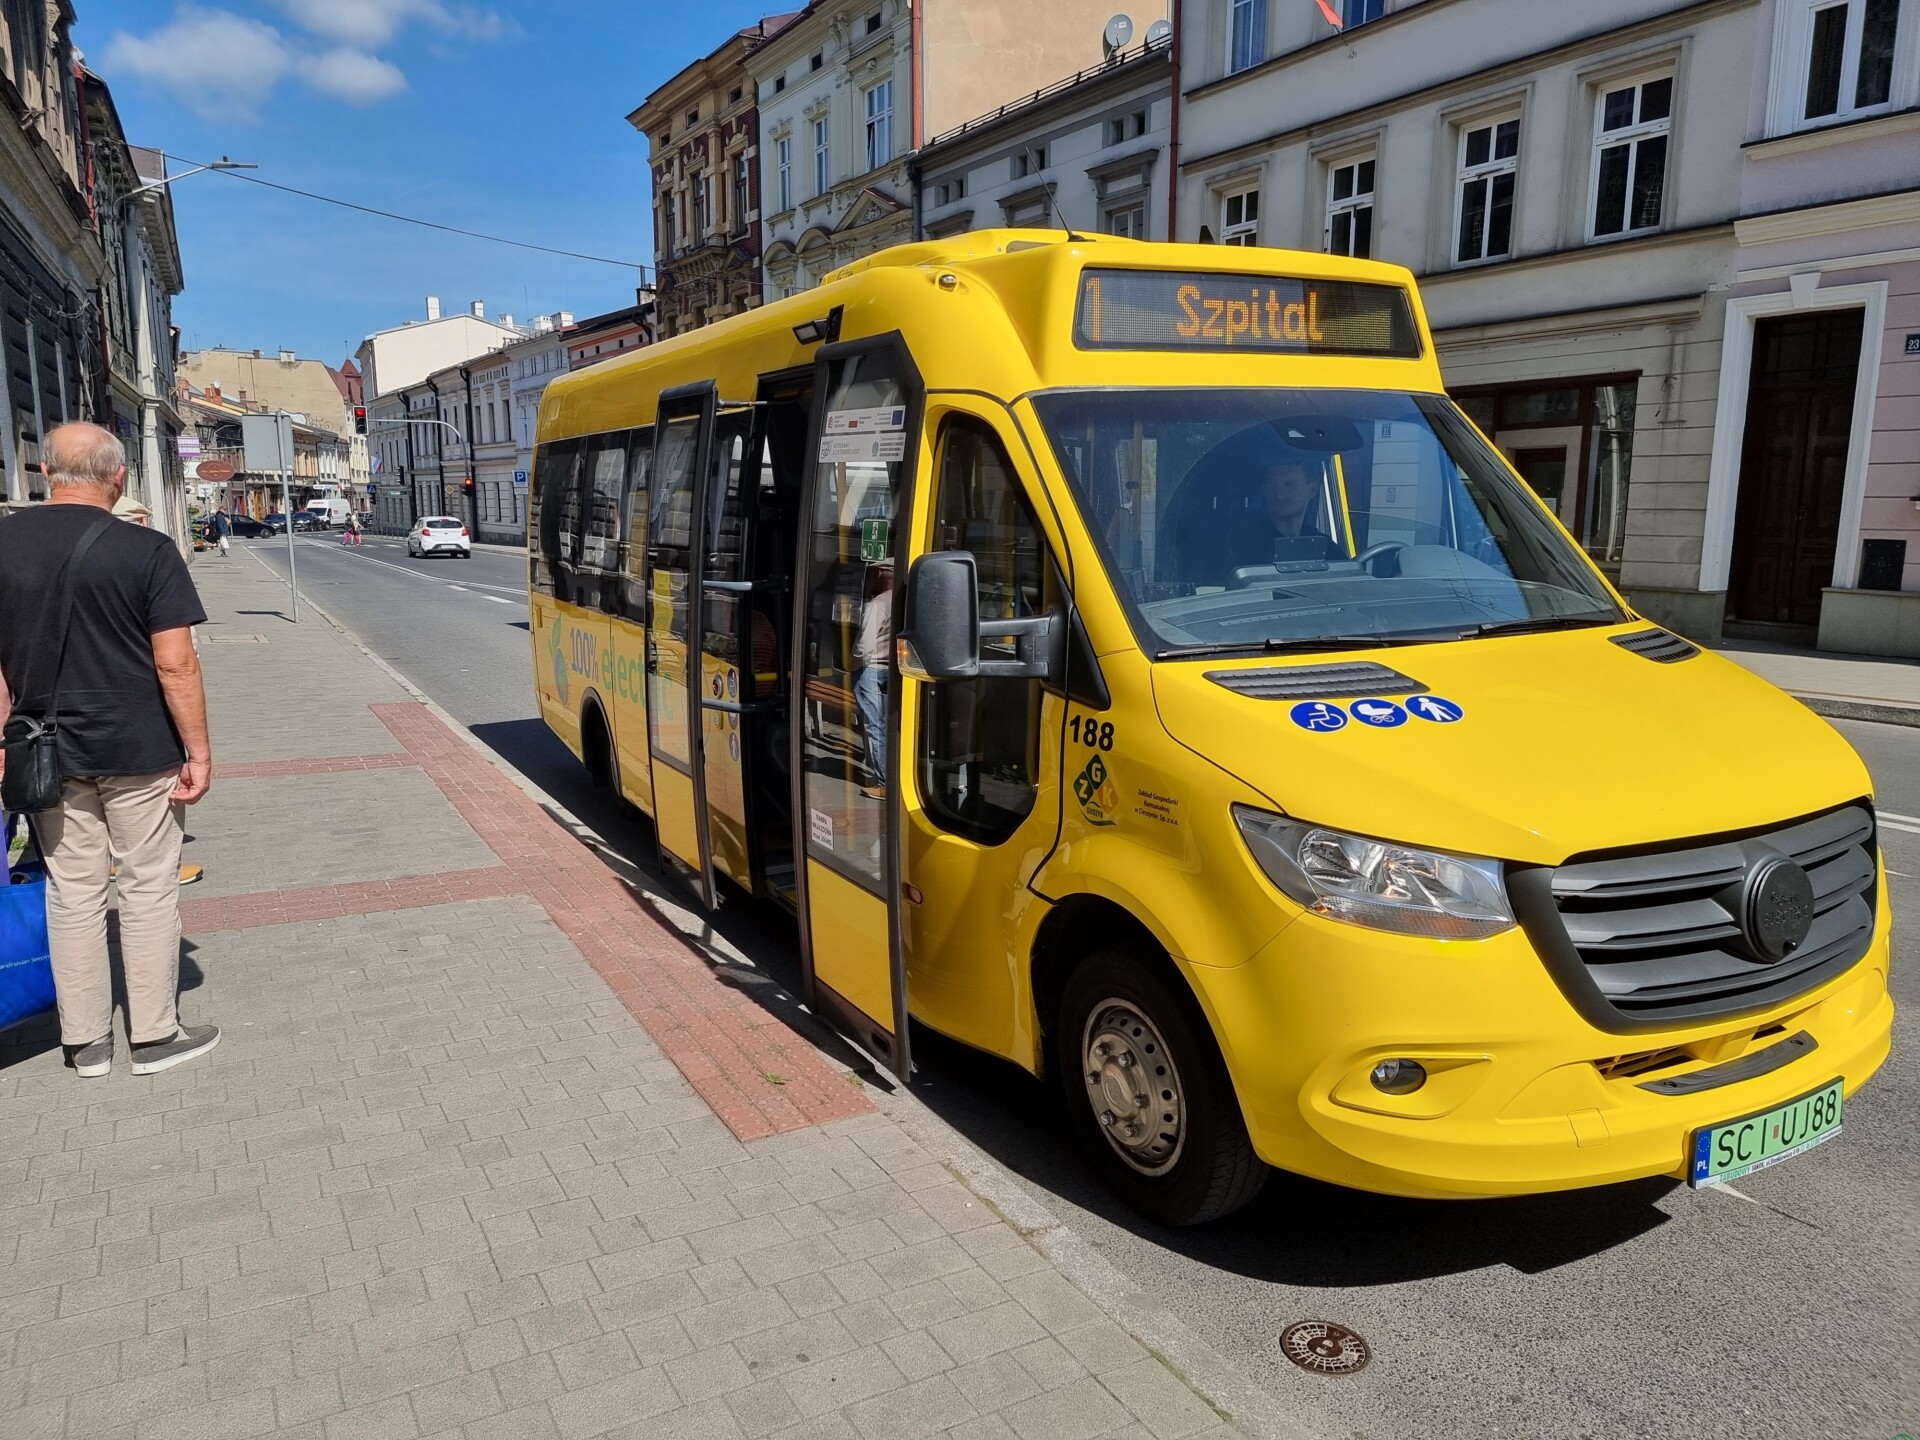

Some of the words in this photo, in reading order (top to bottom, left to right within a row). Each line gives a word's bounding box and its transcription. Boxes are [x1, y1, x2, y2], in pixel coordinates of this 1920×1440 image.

[1086, 277, 1100, 342] 1
[1176, 284, 1324, 346] Szpital
[1908, 339, 1920, 350] 23
[517, 472, 524, 481] P
[569, 626, 599, 684] 100%
[1069, 714, 1115, 752] 188
[1143, 800, 1171, 814] Komunalnej
[1152, 793, 1179, 806] Gospodarki
[0, 959, 30, 969] andinavian
[31, 954, 50, 963] Sleepin
[1716, 1117, 1768, 1168] SCI
[1781, 1089, 1837, 1146] UJ88
[1696, 1160, 1708, 1172] PL
[1719, 1166, 1751, 1183] ZABUDOWY
